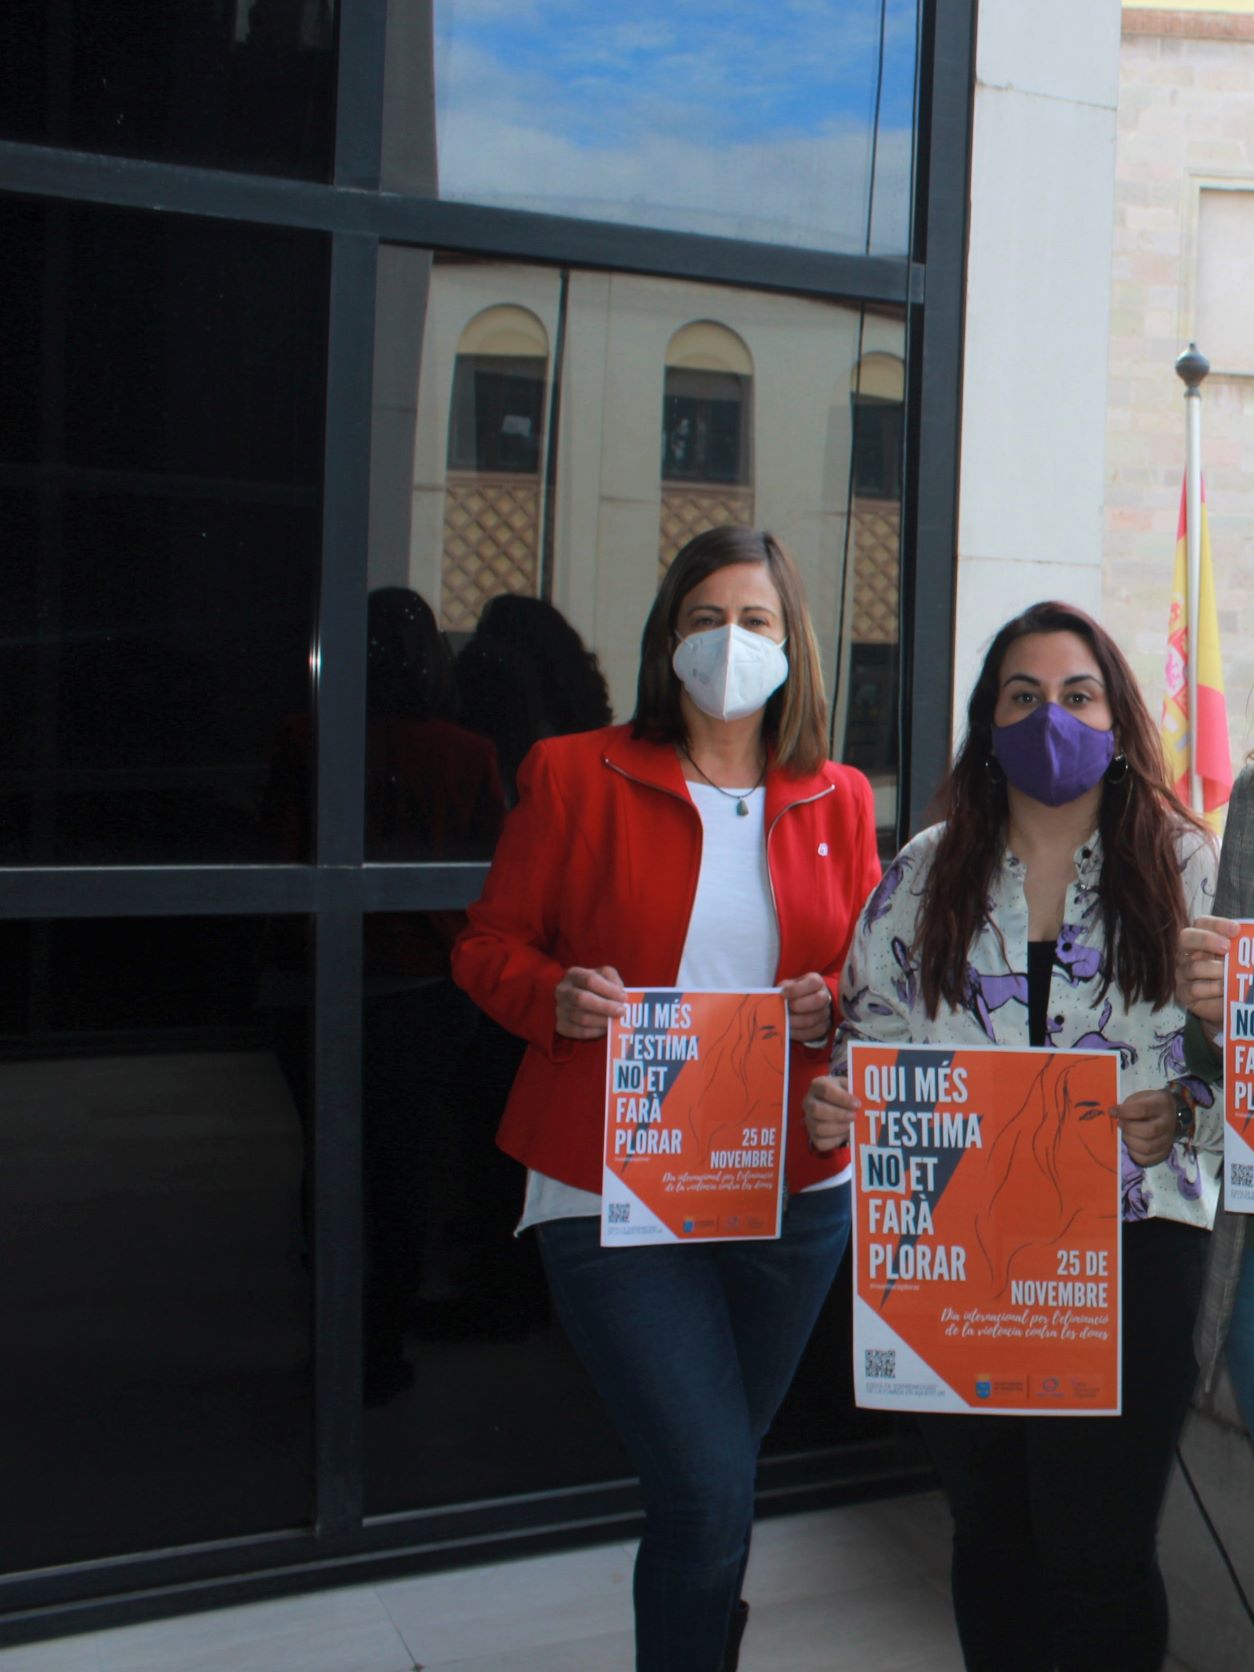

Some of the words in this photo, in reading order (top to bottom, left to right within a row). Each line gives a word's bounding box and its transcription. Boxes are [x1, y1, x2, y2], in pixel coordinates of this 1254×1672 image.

[619, 1003, 648, 1028] QUI
[655, 999, 692, 1029] MÉS
[618, 1033, 699, 1061] T'ESTIMA
[618, 1065, 640, 1089] NO
[646, 1066, 668, 1091] ET
[864, 1065, 906, 1102] QUI
[915, 1061, 968, 1103] MÉS
[616, 1093, 662, 1123] FARÀ
[614, 1128, 682, 1154] PLORAR
[742, 1128, 758, 1146] 25
[761, 1128, 776, 1146] DE
[865, 1110, 983, 1148] T'ESTIMA
[710, 1150, 774, 1169] NOVEMBRE
[868, 1153, 900, 1188] NO
[910, 1156, 938, 1192] ET
[868, 1195, 934, 1235] FARÀ
[869, 1244, 966, 1281] PLORAR
[1056, 1250, 1080, 1276] 25
[1086, 1252, 1108, 1276] DE
[1011, 1280, 1108, 1307] NOVEMBRE
[941, 1307, 960, 1322] Dia
